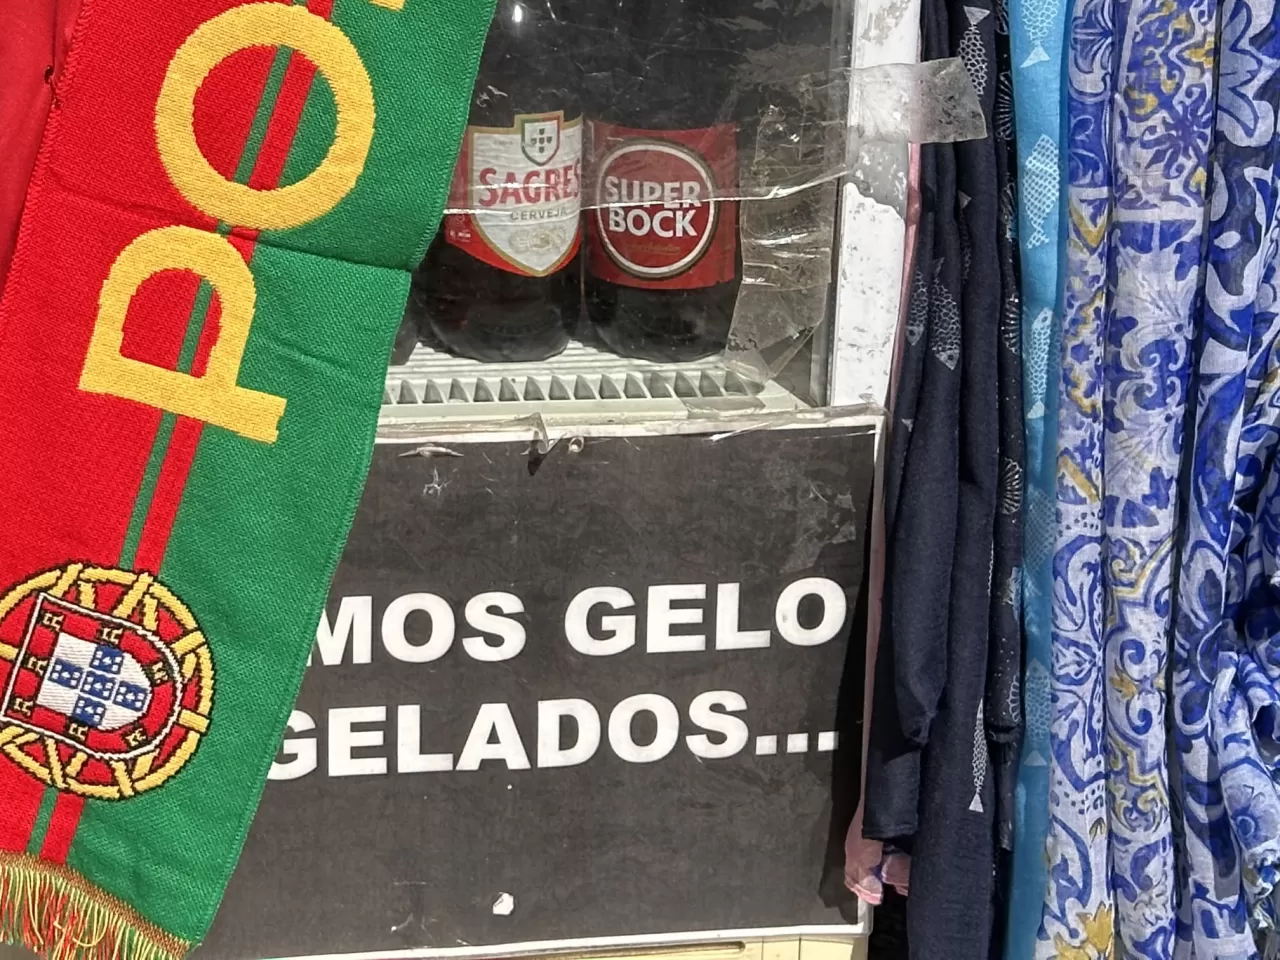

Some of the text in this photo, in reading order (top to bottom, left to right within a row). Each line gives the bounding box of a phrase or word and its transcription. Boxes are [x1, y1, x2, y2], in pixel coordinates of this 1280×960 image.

[604, 175, 702, 209] SUPER
[510, 207, 571, 222] CERVEJA
[608, 209, 699, 239] BOCK
[564, 577, 847, 657] GELO
